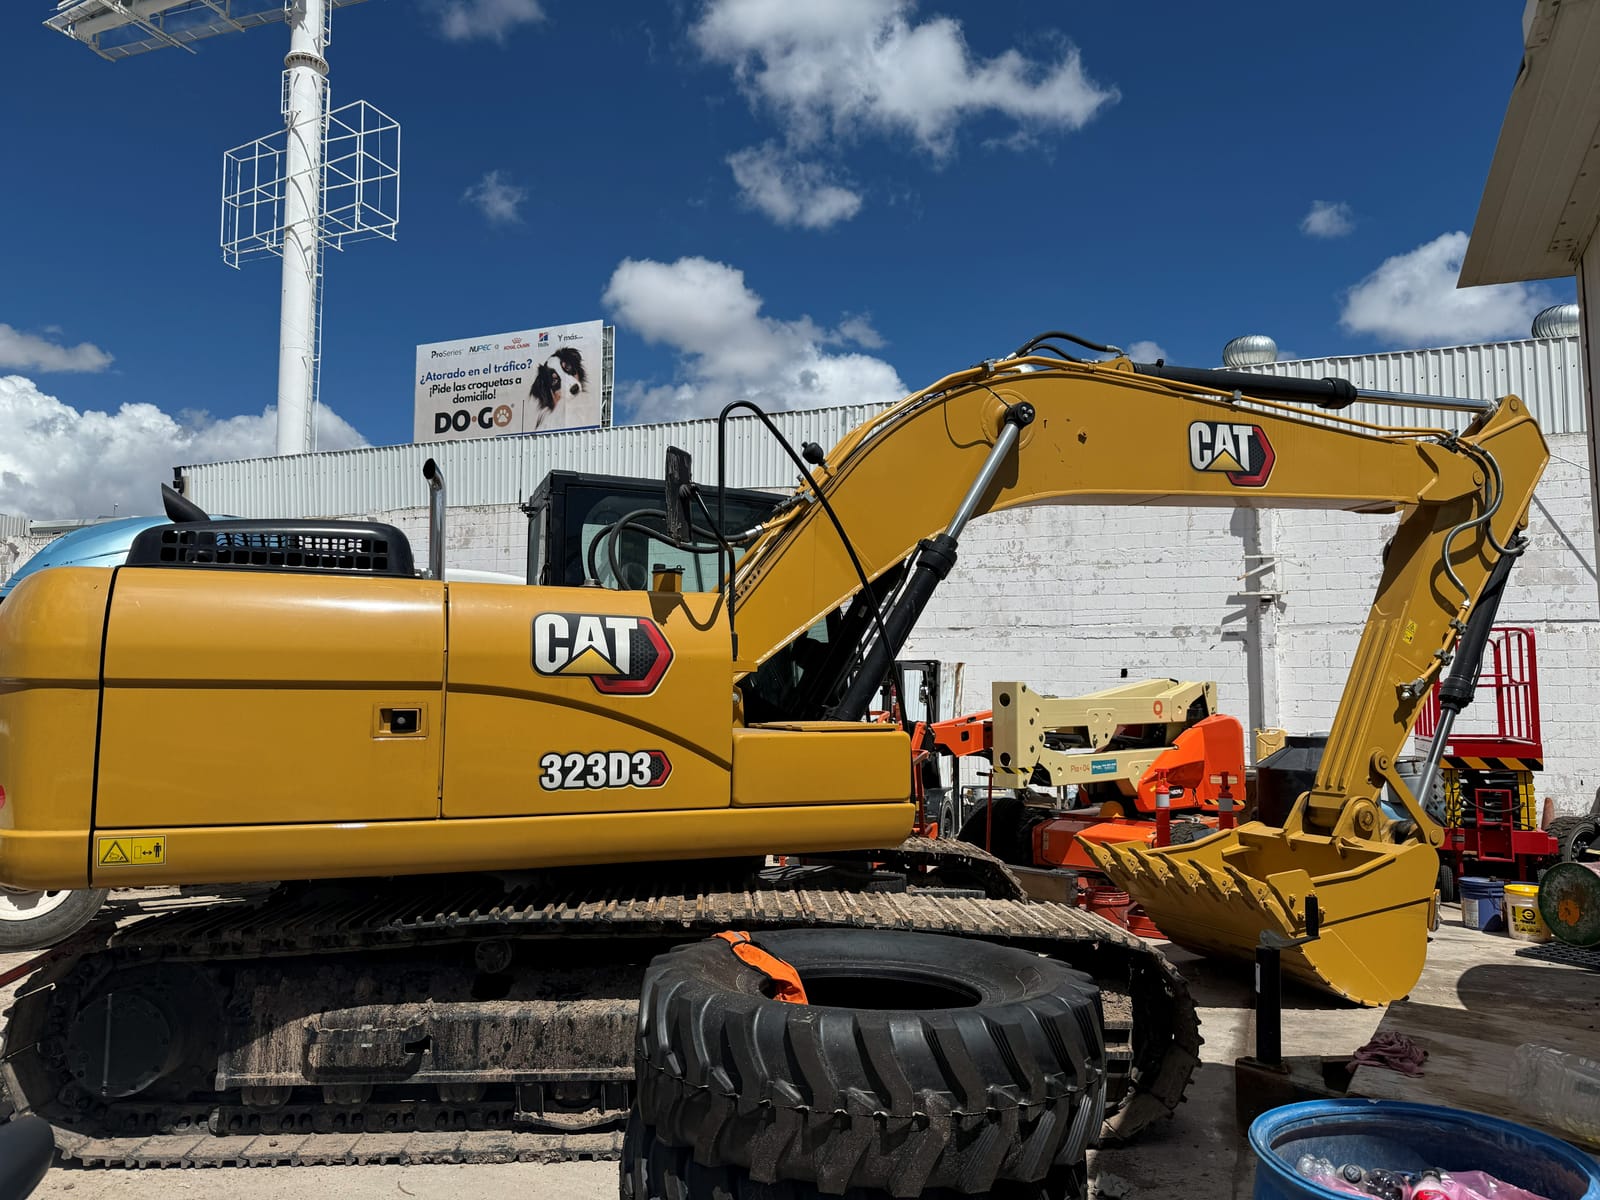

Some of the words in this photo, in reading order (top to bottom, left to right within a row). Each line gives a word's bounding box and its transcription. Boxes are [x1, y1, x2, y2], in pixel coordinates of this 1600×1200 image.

[469, 343, 492, 352] NUPEC
[557, 334, 563, 342] Y
[431, 350, 462, 358] ProSeries
[420, 368, 466, 385] ¿Atorado
[468, 368, 480, 376] en
[482, 363, 492, 374] el
[494, 359, 533, 373] tráfico?
[429, 383, 451, 398] ¡Pide
[453, 382, 466, 392] las
[467, 377, 514, 391] croquetas
[515, 377, 522, 385] a
[452, 389, 497, 404] domicilio!
[1189, 421, 1253, 472] CAT
[534, 613, 638, 675] CAT
[540, 751, 651, 789] 323D3
